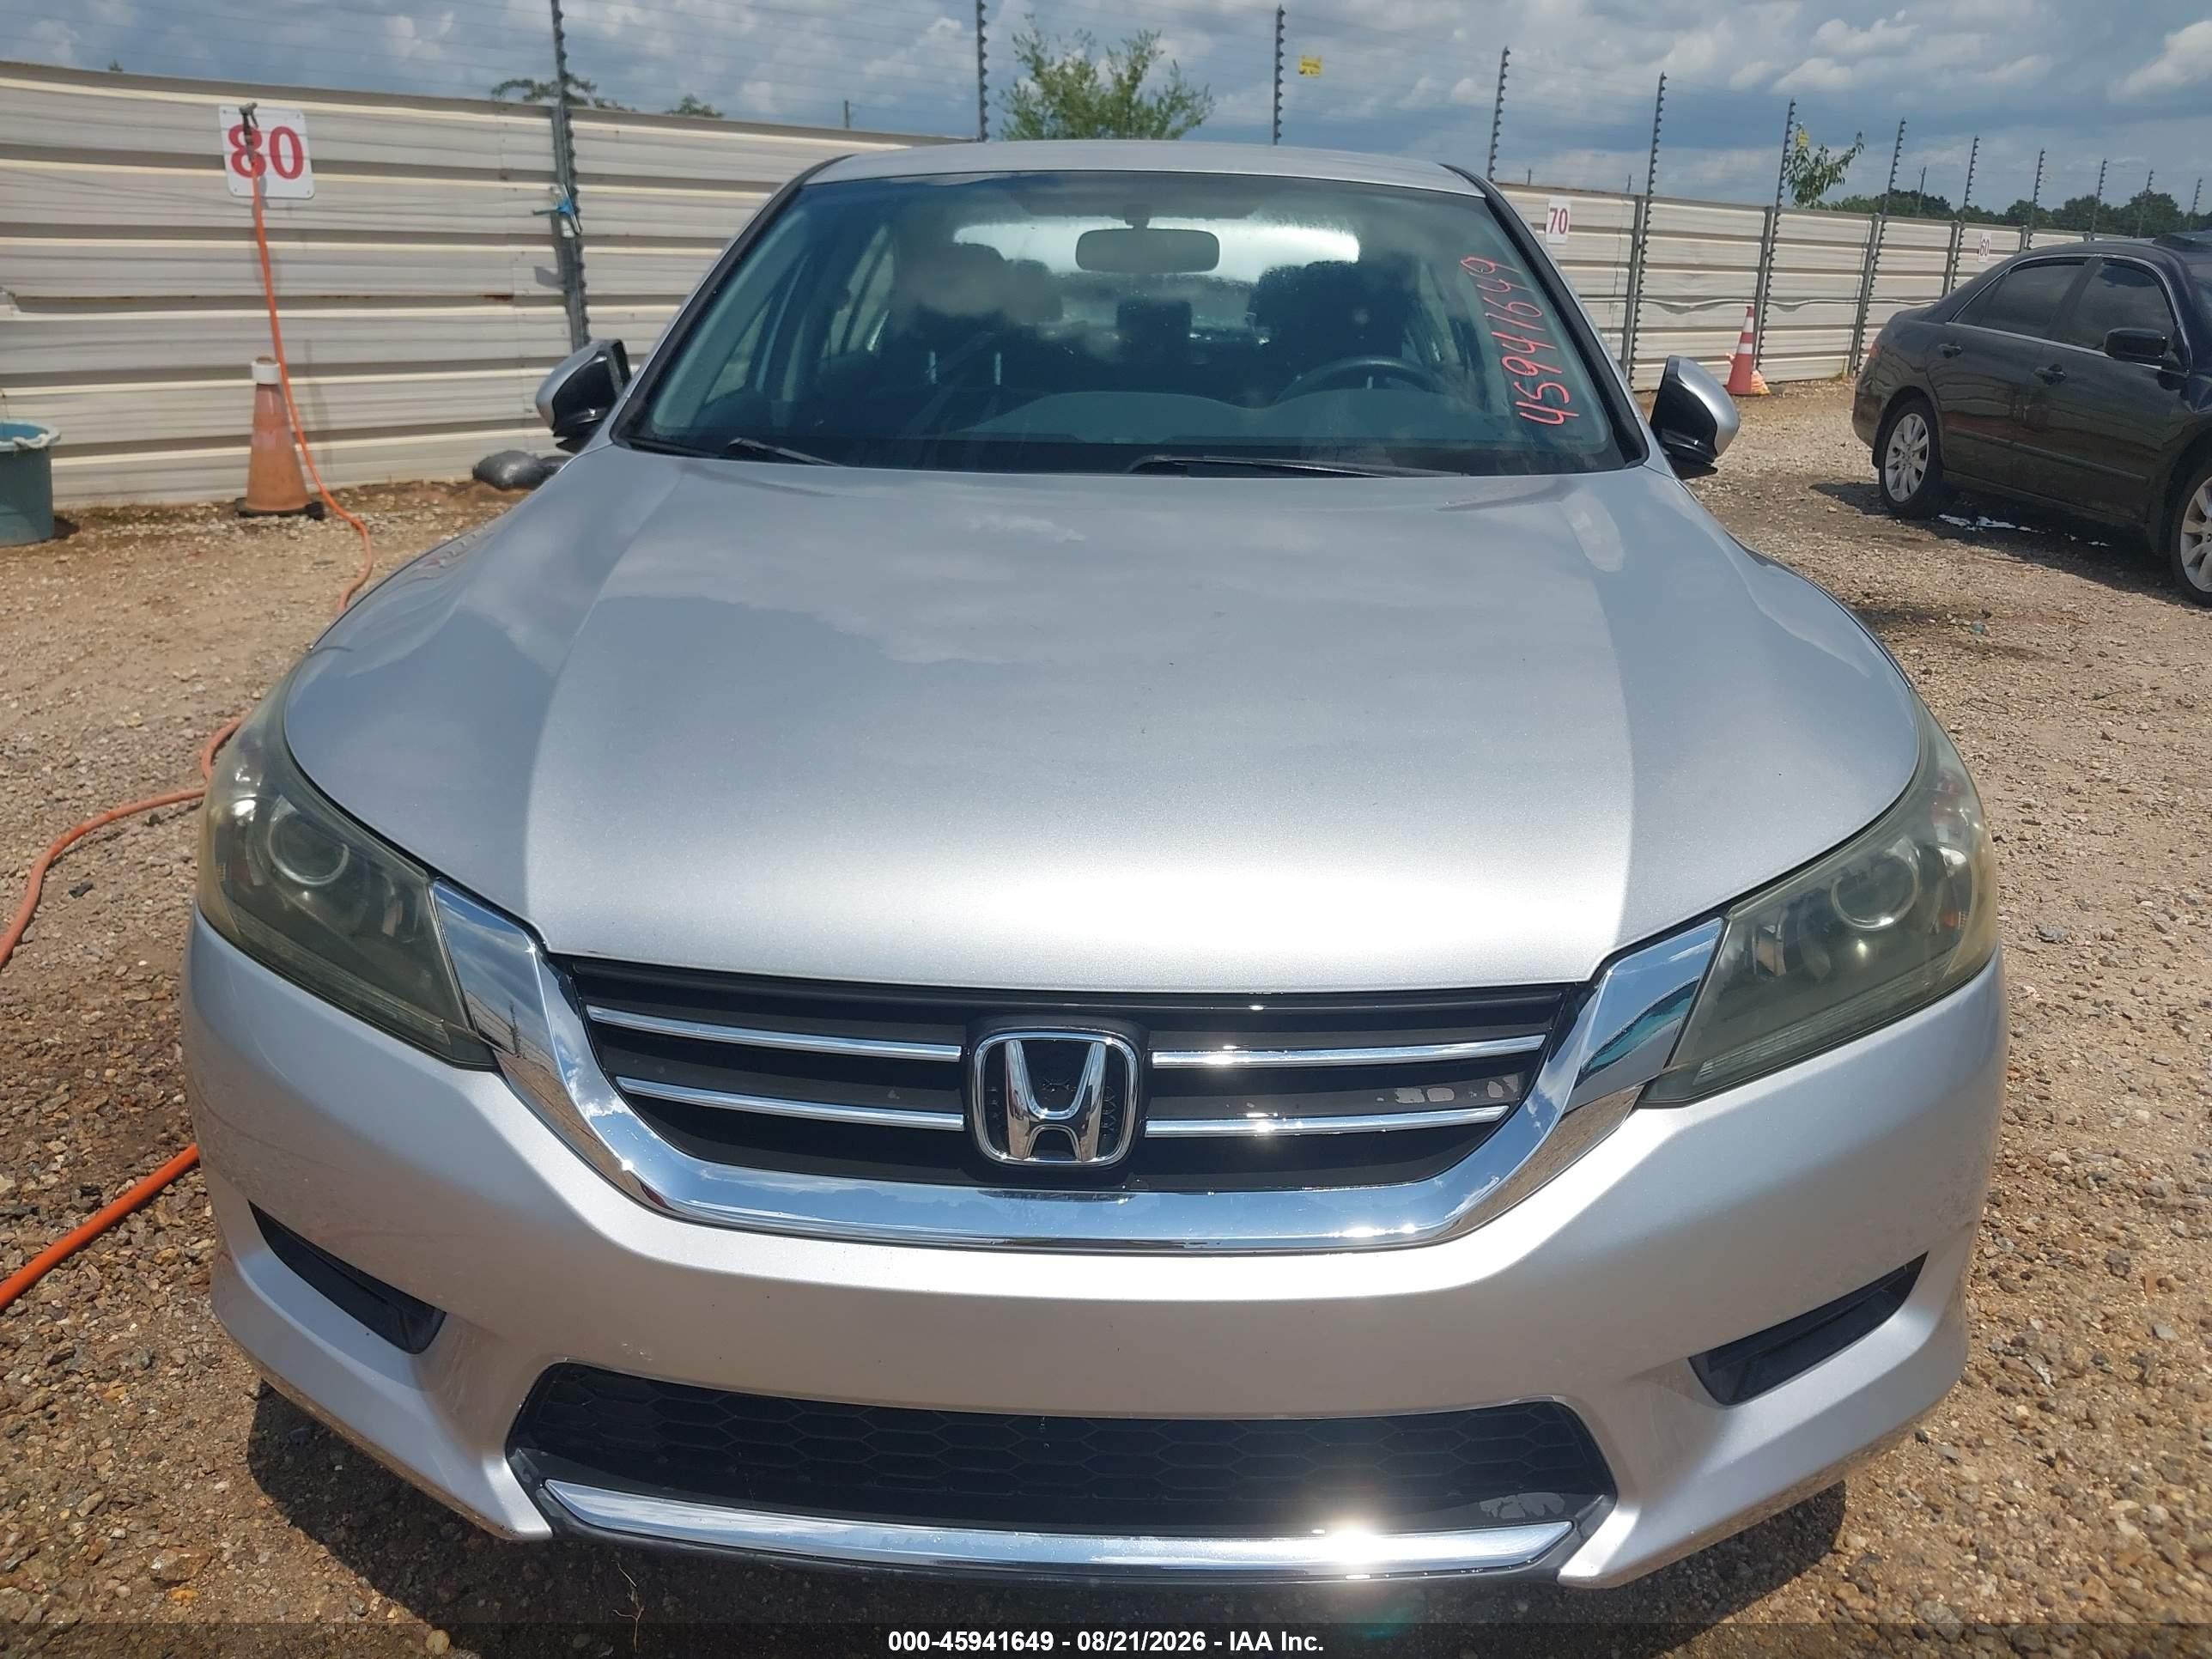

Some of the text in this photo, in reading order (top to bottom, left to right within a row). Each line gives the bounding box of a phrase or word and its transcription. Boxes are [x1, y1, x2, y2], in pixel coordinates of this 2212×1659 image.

[228, 125, 304, 179] 80
[1550, 208, 1568, 234] 70
[1461, 257, 1579, 424] 45941649
